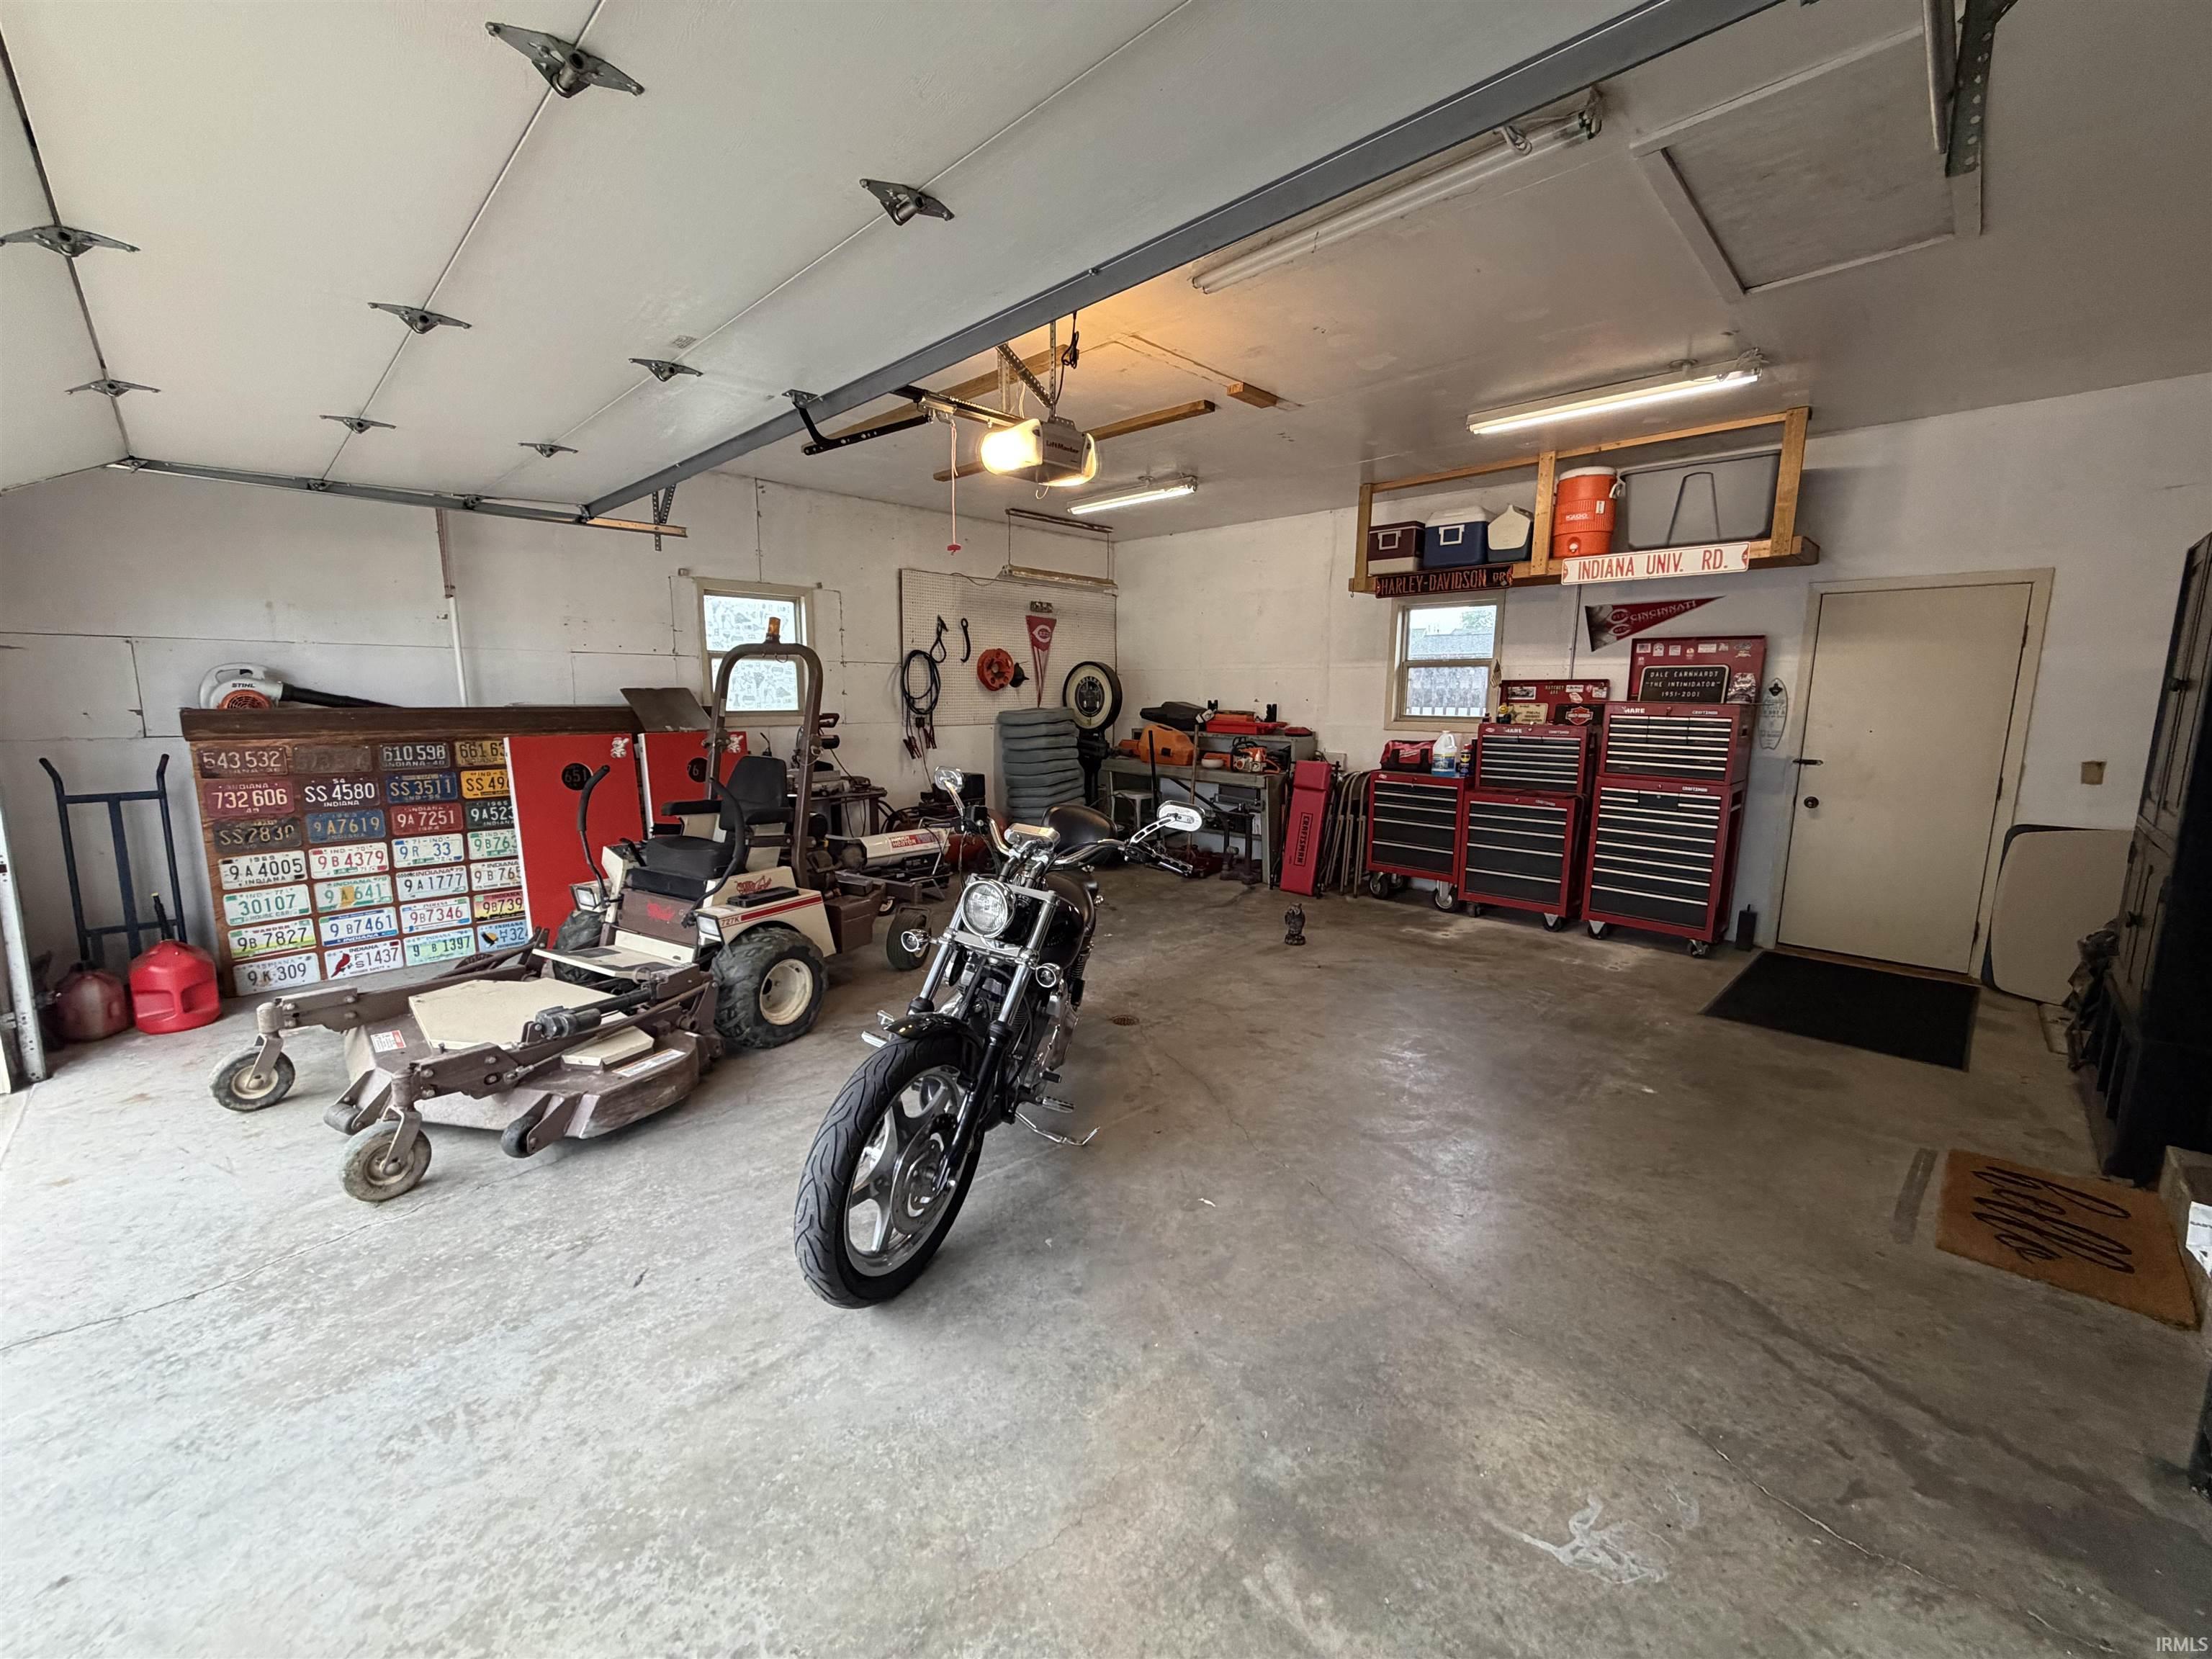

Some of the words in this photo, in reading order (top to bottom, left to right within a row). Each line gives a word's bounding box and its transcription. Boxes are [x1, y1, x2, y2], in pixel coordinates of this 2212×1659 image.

[1046, 440, 1079, 453] LiftMaster
[1578, 557, 1635, 580] INDIANA
[1646, 552, 1683, 575] UNIV.
[1701, 549, 1727, 570] RD.
[1381, 570, 1487, 595] HARLEY-DAVIDSON
[1629, 600, 1696, 622] CINCINNATI
[383, 746, 412, 763] 610
[417, 745, 446, 761] 598
[459, 742, 487, 758] 661
[202, 752, 240, 769] 543
[245, 750, 282, 768] 532
[466, 778, 484, 791] SS
[565, 769, 587, 783] 651
[304, 786, 328, 802] SS
[332, 782, 375, 801] 4580
[390, 782, 410, 797] SS
[414, 778, 451, 796] 3511
[212, 791, 249, 809] 732
[251, 788, 288, 807] 606
[418, 810, 455, 826] 7251
[220, 829, 243, 846] SS
[1296, 815, 1310, 863] CRAFTSMAN
[433, 842, 451, 857] 33
[245, 876, 287, 885] INDIANA
[238, 894, 296, 917] 30107
[249, 912, 274, 921] HOUSE
[721, 915, 739, 927] 727K
[252, 925, 290, 934] WANDER
[263, 927, 307, 948] 7827
[342, 933, 379, 943] INDIANA
[443, 935, 470, 952] 1397
[276, 963, 307, 981] 309
